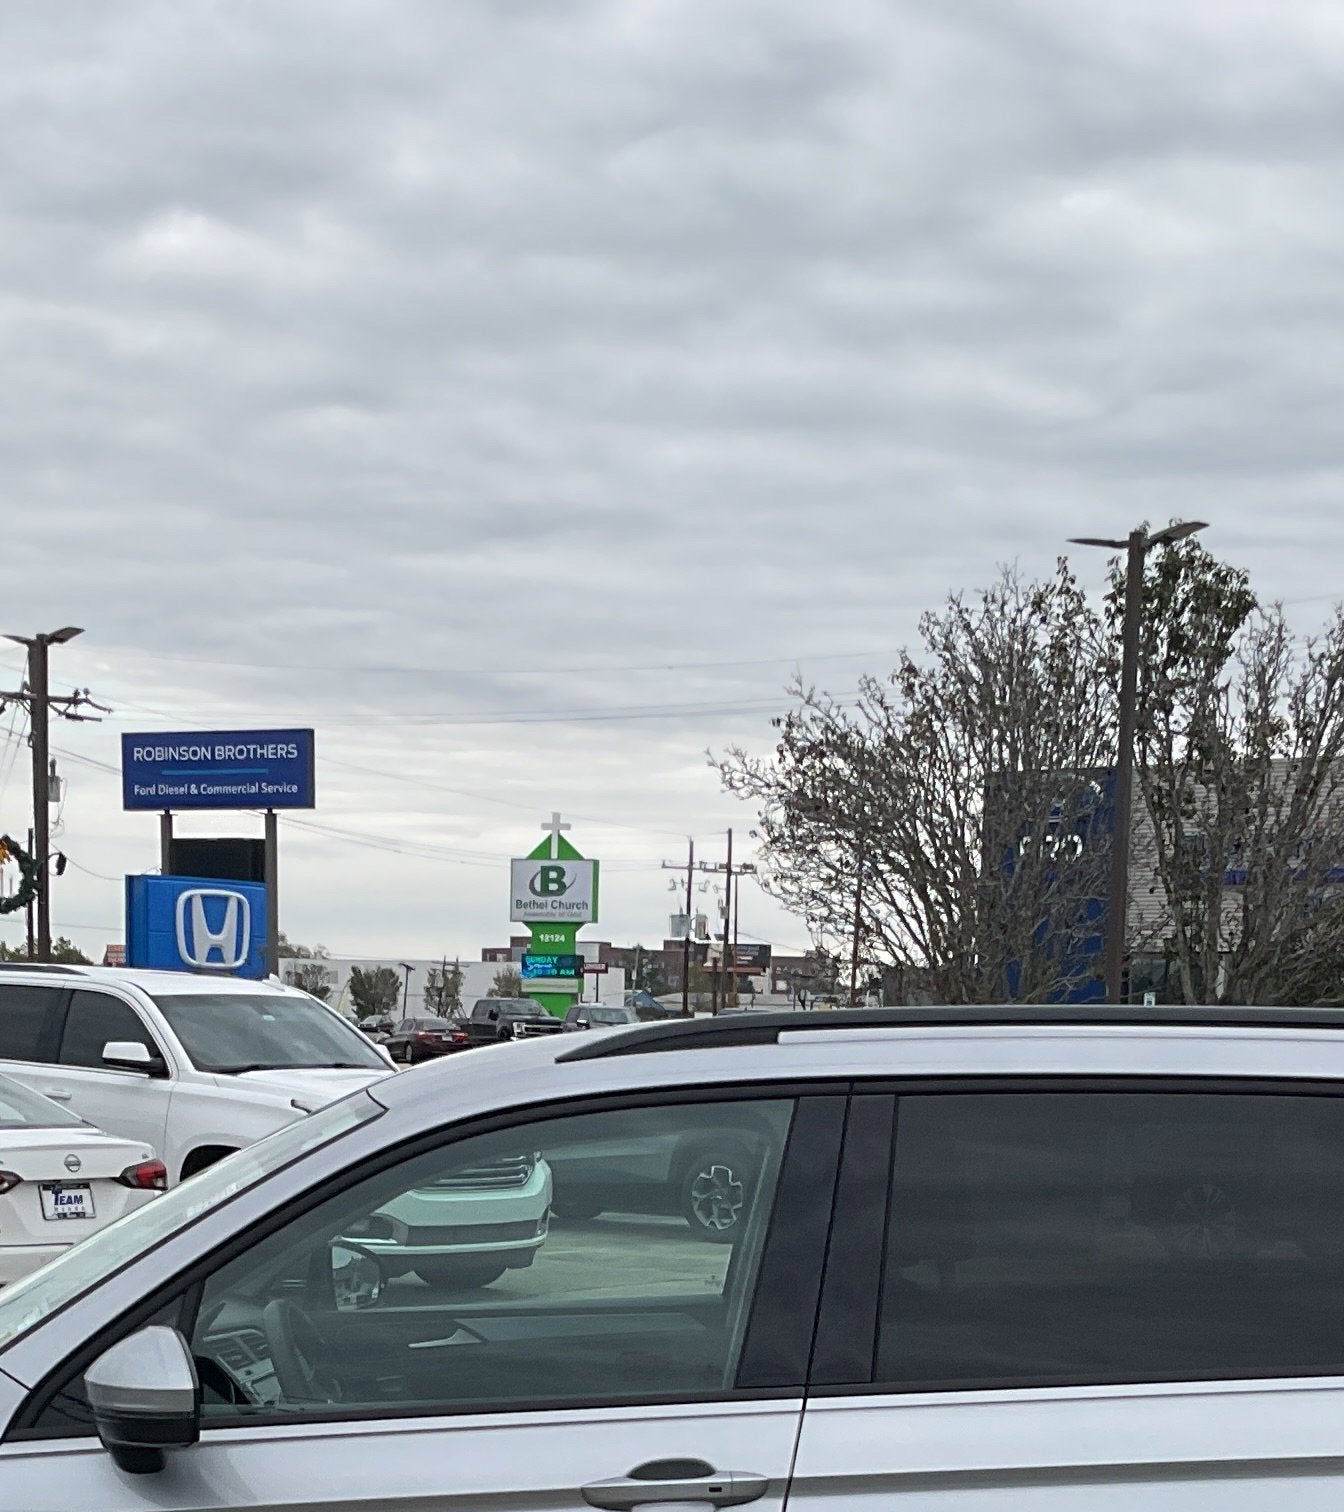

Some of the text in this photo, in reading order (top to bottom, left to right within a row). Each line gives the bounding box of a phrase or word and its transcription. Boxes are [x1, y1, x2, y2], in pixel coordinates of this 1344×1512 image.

[133, 744, 298, 762] ROBINSON BROTHERS
[134, 782, 298, 796] Ford Diesel & Commercial Service
[515, 899, 589, 910] Bethel Church
[51, 1189, 83, 1206] TEAM
